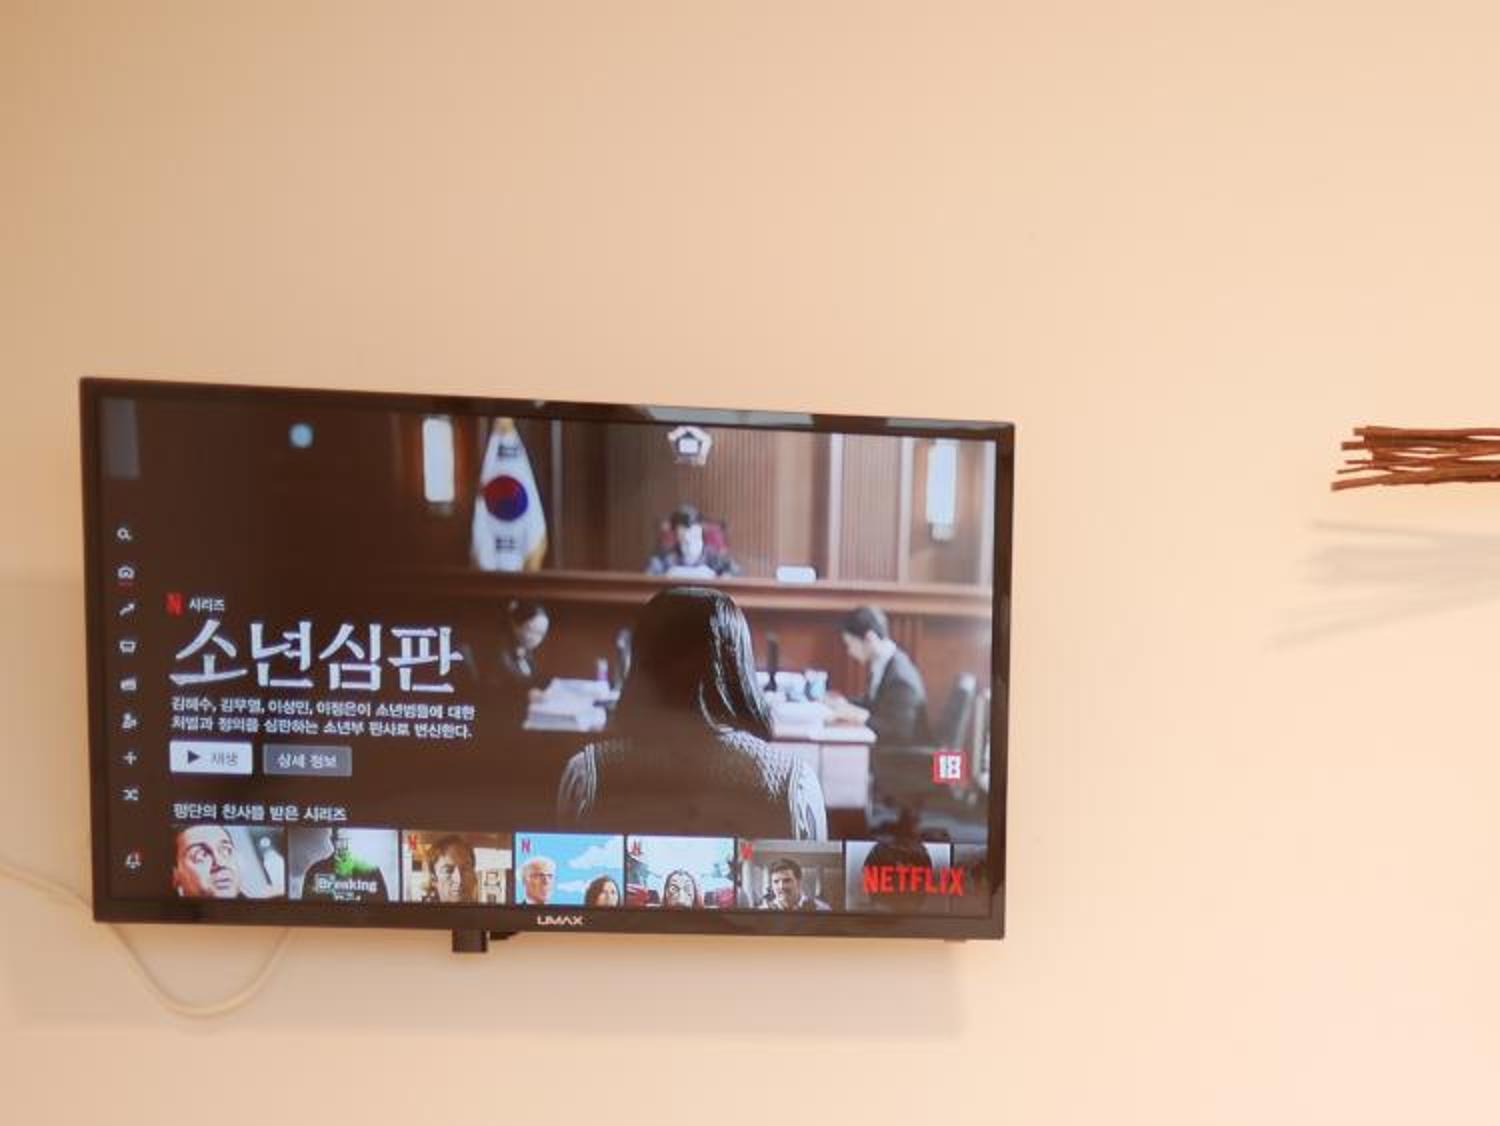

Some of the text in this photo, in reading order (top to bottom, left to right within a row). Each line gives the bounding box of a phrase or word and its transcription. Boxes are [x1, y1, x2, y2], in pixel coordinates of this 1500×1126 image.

[188, 597, 225, 612] 시리즈
[168, 618, 464, 692] 소년심판
[447, 705, 475, 720] 대한
[263, 719, 319, 735] 심판하는
[414, 723, 473, 739] 변신한다.
[277, 754, 305, 769] 상세
[270, 805, 299, 821] 받은
[303, 806, 348, 821] 시리즈
[318, 876, 377, 894] Breaking
[863, 866, 964, 896] NETFLIX
[537, 915, 584, 925] UMAX
